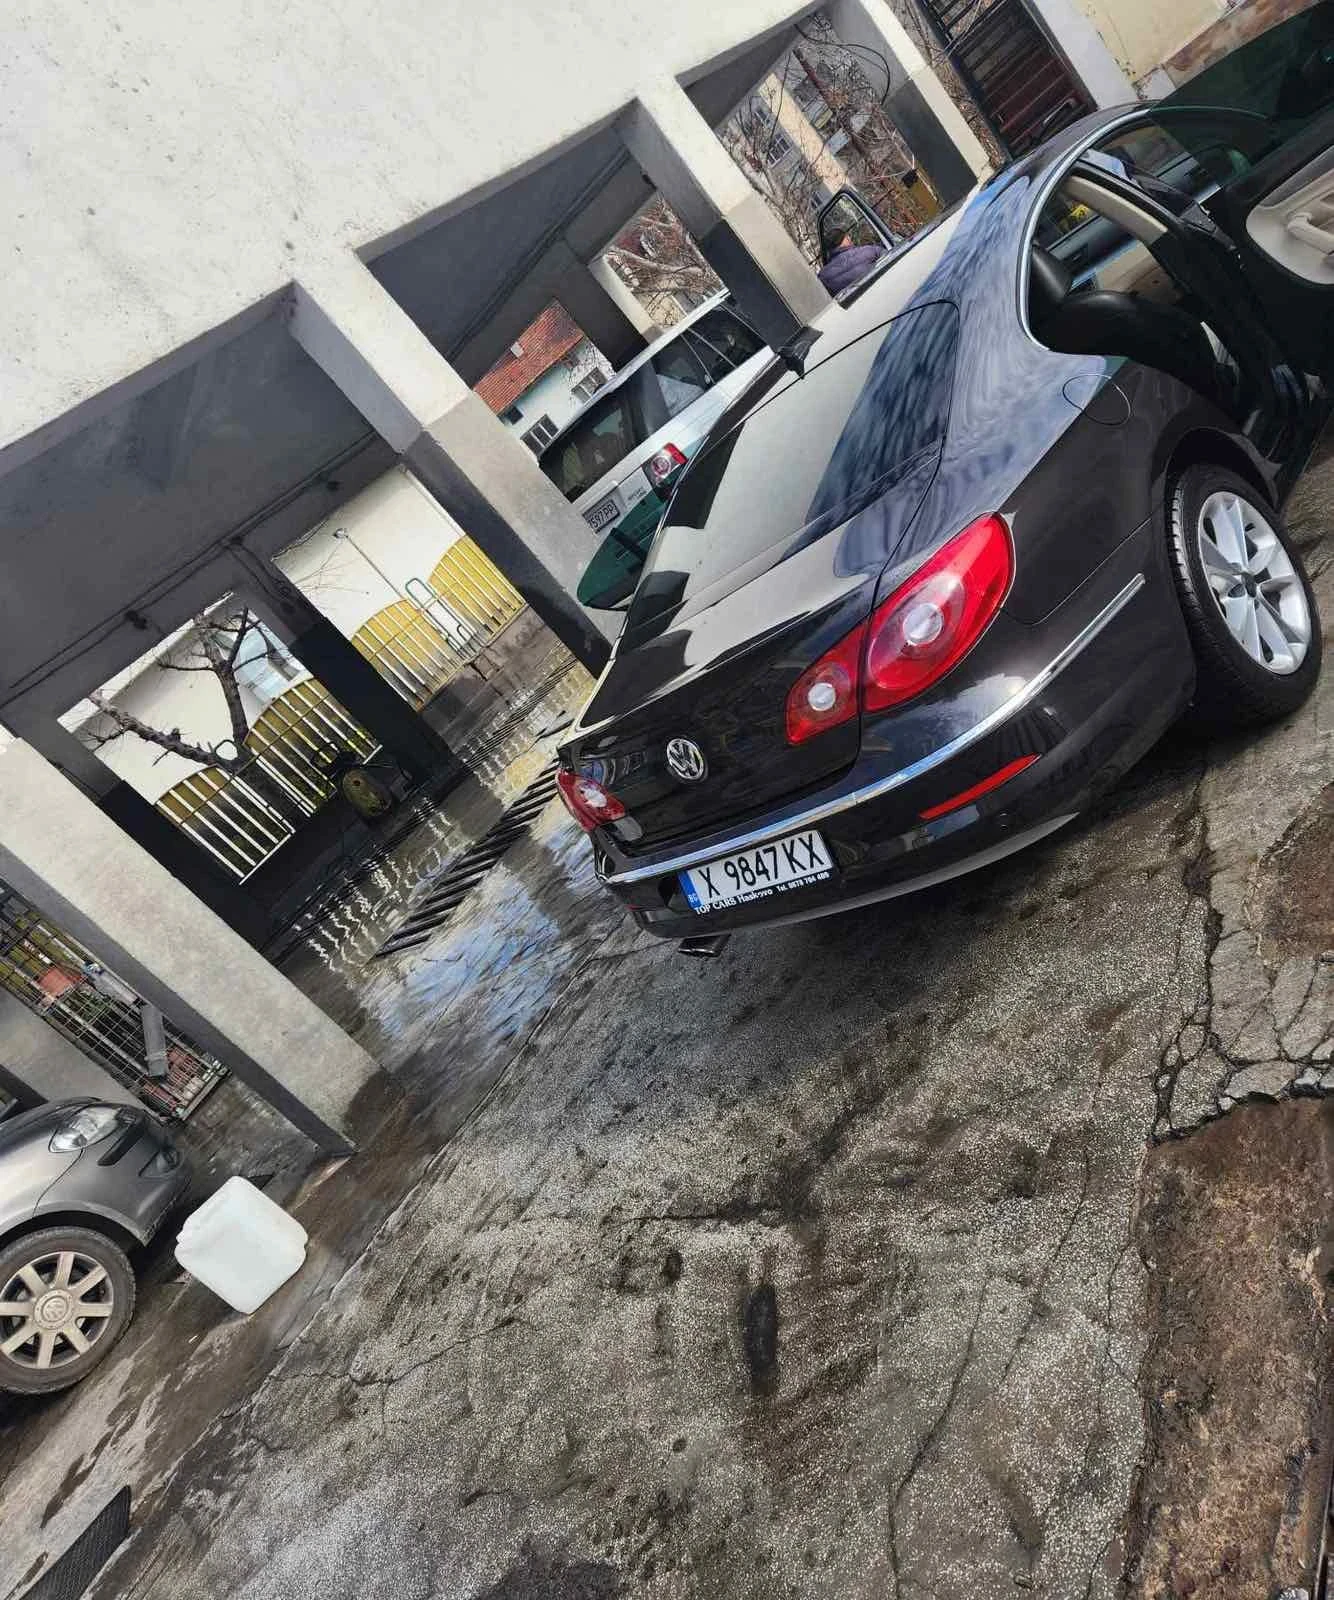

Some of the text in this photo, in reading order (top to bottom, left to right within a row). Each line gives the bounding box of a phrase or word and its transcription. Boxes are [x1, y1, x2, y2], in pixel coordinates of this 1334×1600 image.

[667, 739, 704, 780] VW
[698, 867, 720, 899] X
[694, 904, 711, 916] TOP
[712, 897, 737, 911] CARS
[737, 888, 773, 904] Haskovo
